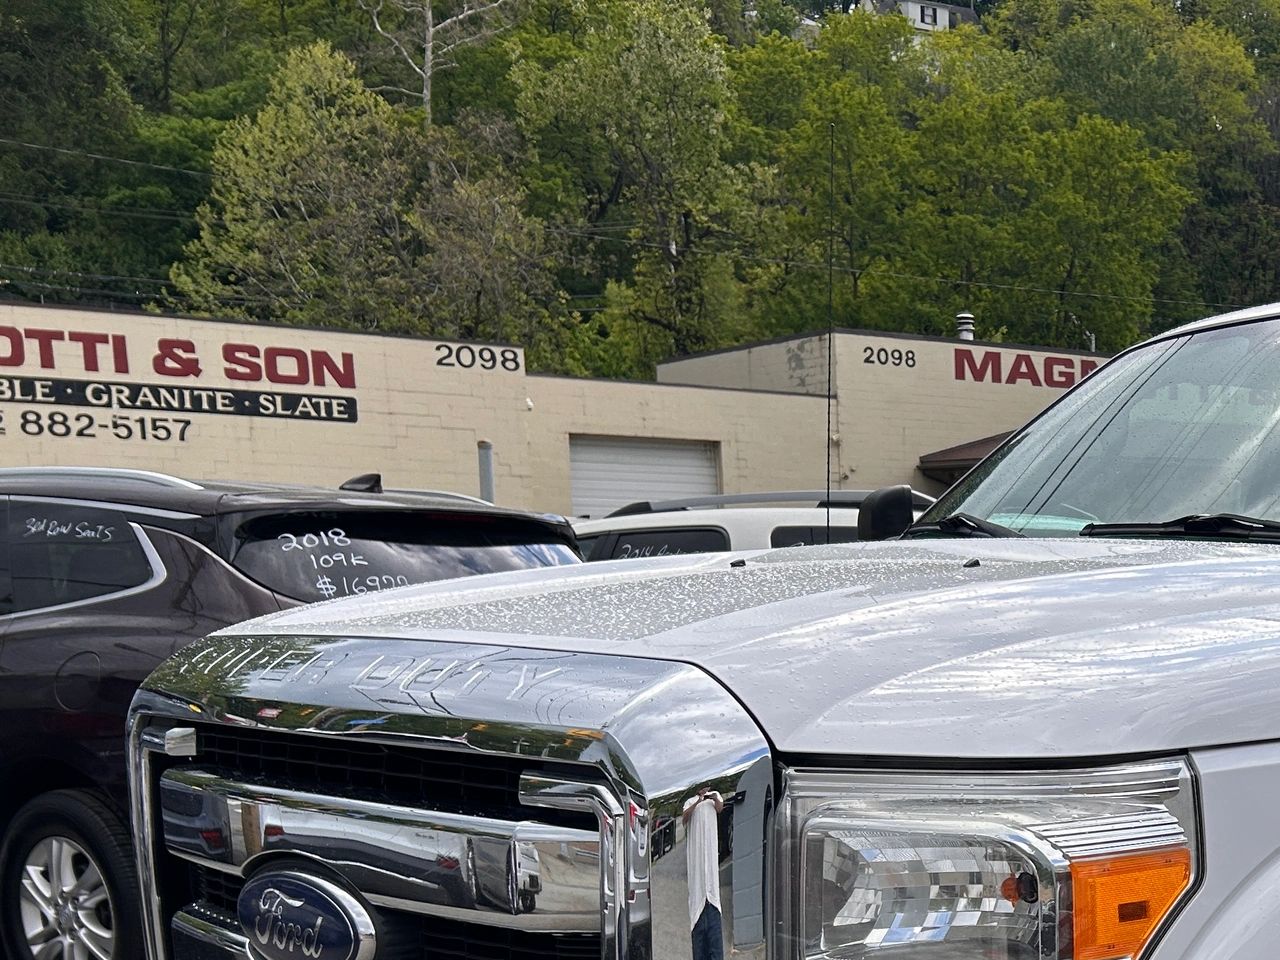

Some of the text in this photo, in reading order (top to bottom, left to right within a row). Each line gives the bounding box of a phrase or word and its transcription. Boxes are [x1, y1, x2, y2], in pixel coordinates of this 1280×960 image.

[152, 338, 202, 377] &
[221, 342, 357, 389] SON
[435, 344, 520, 372] 2098
[863, 346, 917, 368] 2098
[85, 383, 235, 412] GRANITE
[258, 394, 349, 419] SLATE
[20, 409, 192, 442] 882-5157
[277, 527, 351, 551] 2018
[256, 888, 324, 959] Ford
